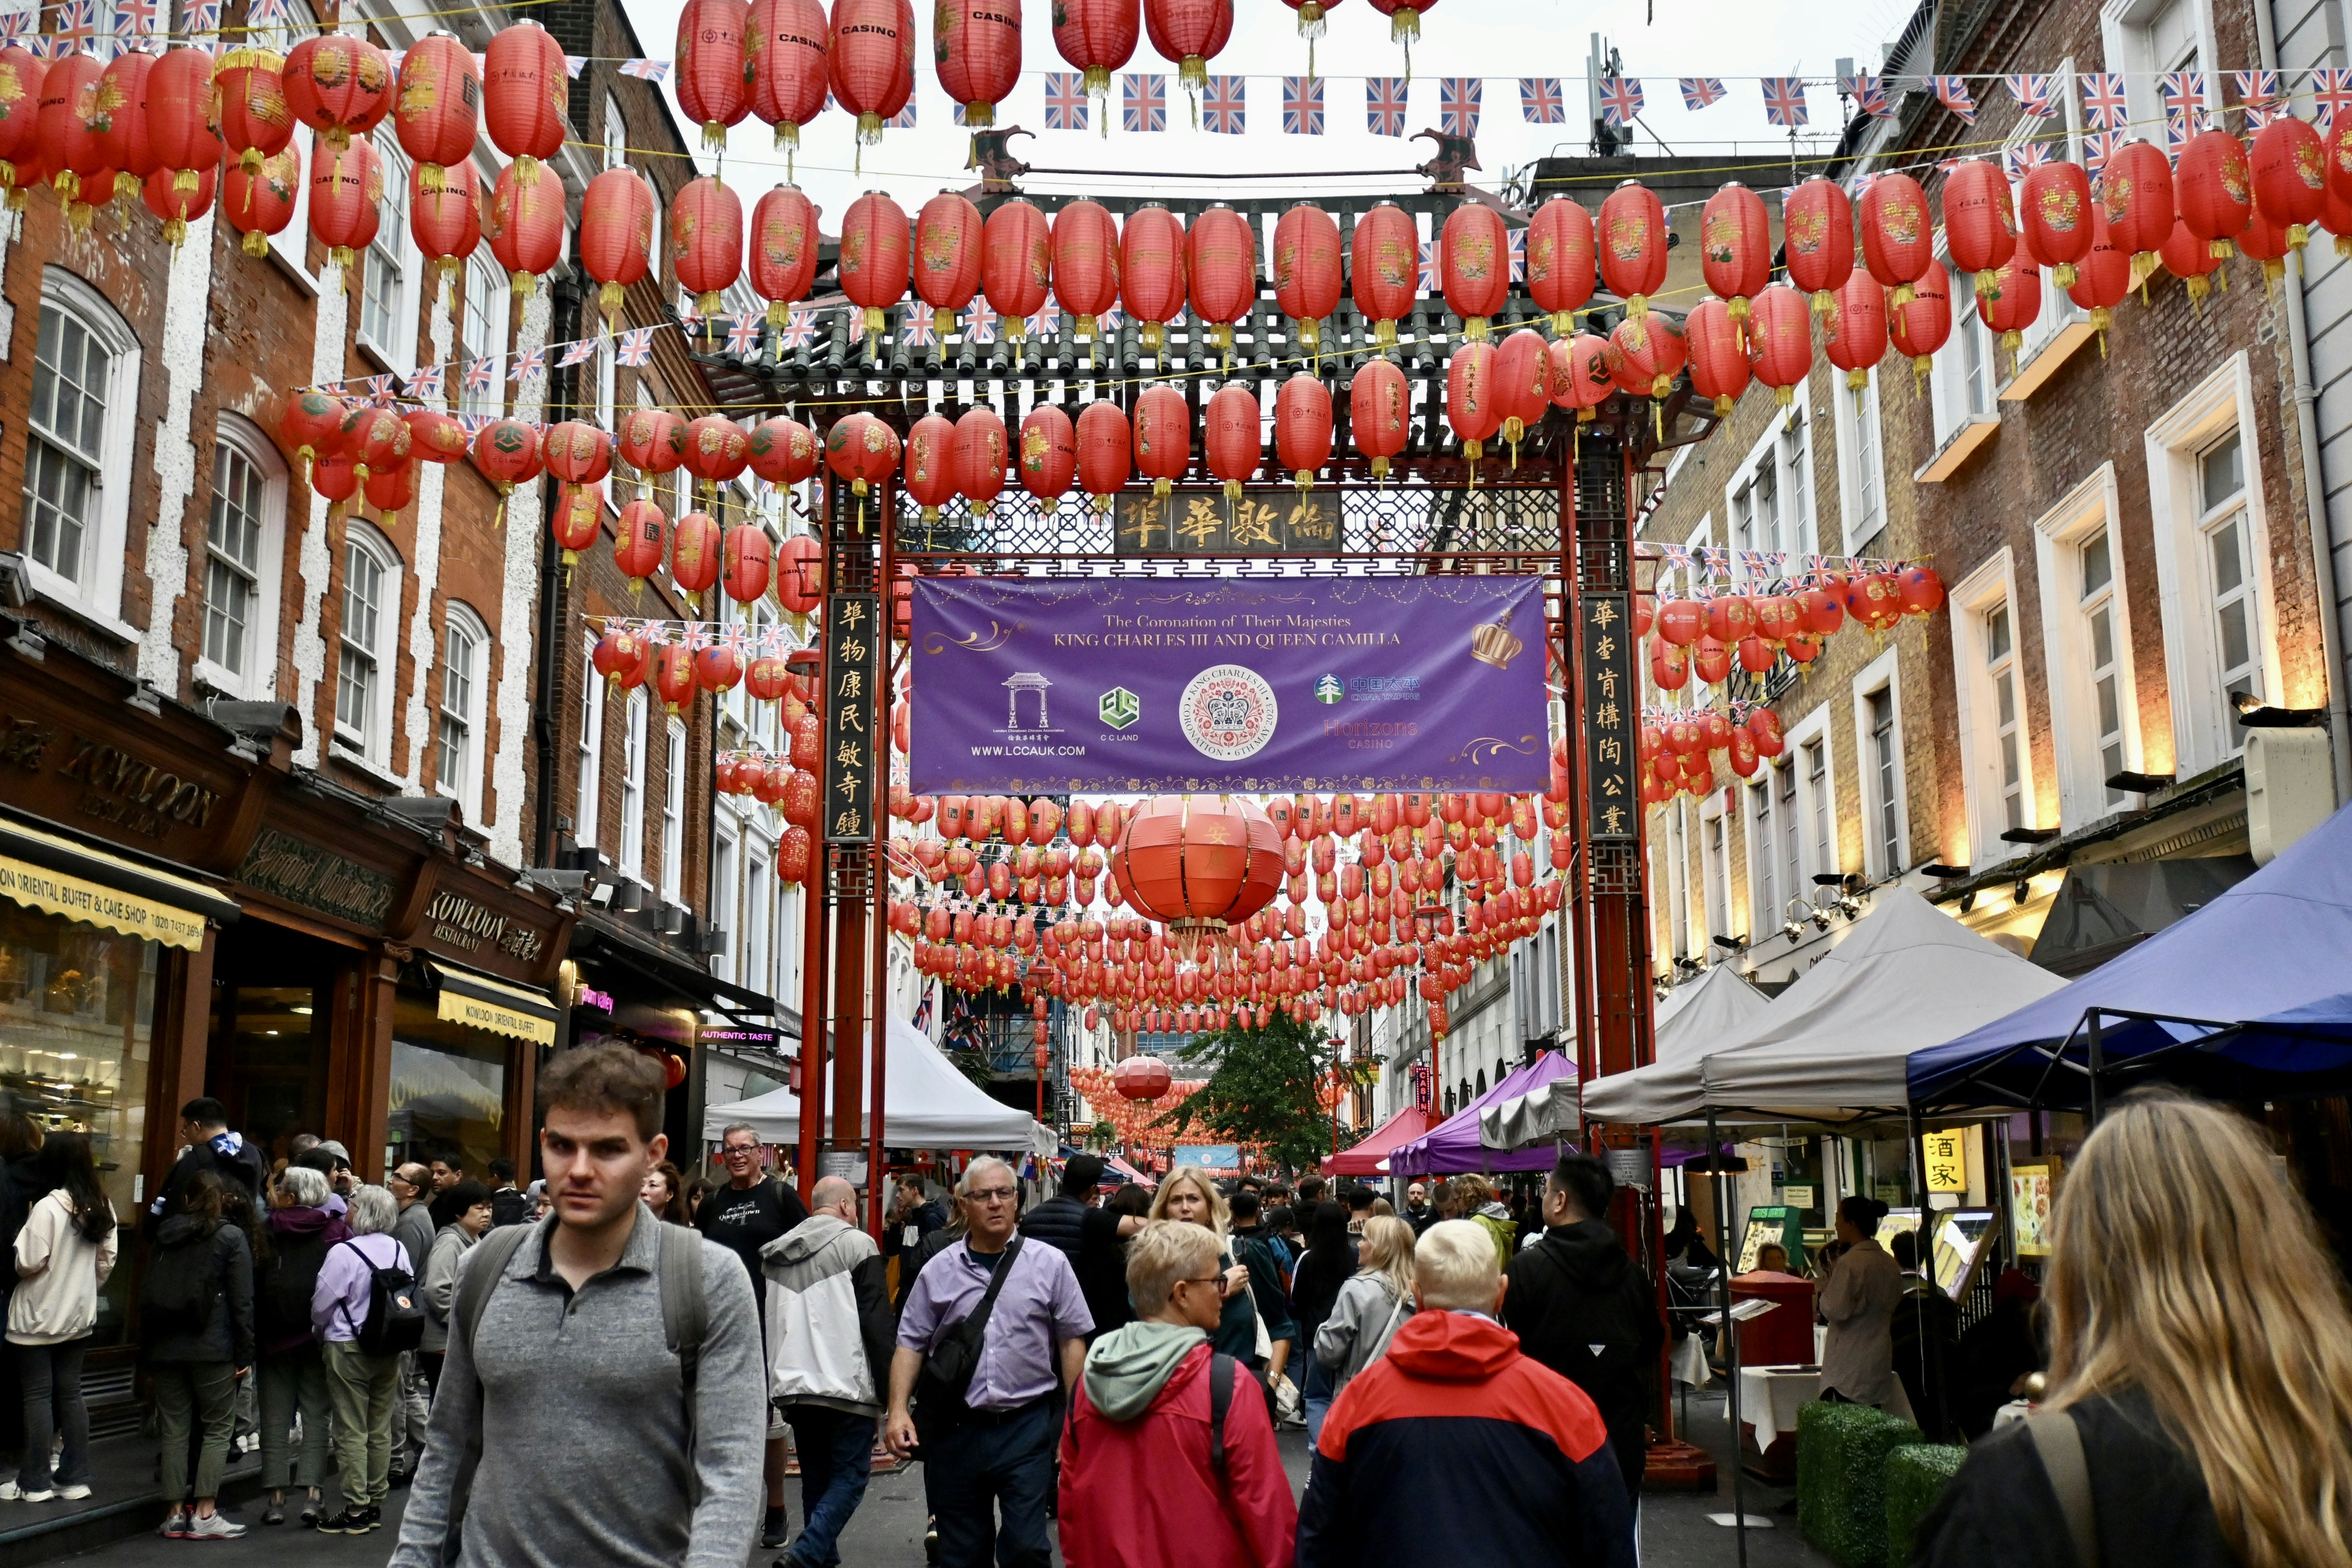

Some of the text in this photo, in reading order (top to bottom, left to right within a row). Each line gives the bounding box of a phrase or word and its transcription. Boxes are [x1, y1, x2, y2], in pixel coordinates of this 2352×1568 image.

[841, 25, 896, 38] CASINO
[316, 176, 359, 185] CASNO
[1103, 614, 1351, 630] The Coronation of Their Majesties
[1054, 633, 1401, 649] KING CHARLES III AND QUEEN CAMILLA
[1189, 669, 1268, 696] KING CHARLES III
[1350, 676, 1420, 692] 中国太平
[1382, 693, 1420, 701] TAIPING
[1183, 704, 1224, 757] CORONATION
[1235, 703, 1274, 757] 6TH MAY 2023
[1324, 719, 1418, 737] Horizons
[971, 746, 1086, 756] WWW.LCCAUK.COM
[1348, 739, 1394, 749] CASINO
[1203, 822, 1231, 845] 安
[18, 872, 59, 902] ORIENTAL
[61, 887, 92, 909] BUFFET
[94, 896, 102, 913] &
[104, 898, 122, 920] CAKE
[125, 904, 147, 925] SHOP
[151, 914, 169, 930] T:020
[171, 919, 185, 935] 7437
[186, 923, 204, 937] 1694
[425, 891, 509, 942] KOWLOON
[432, 923, 482, 953] RESTAURANT
[581, 987, 614, 1016] plum valley
[466, 1004, 535, 1034] KOWLOON ORIENTAL BUFFET
[701, 1030, 773, 1041] AUTHENTIC TASTE
[1929, 1137, 1958, 1186] 酒家
[719, 1209, 760, 1221] Queenstown
